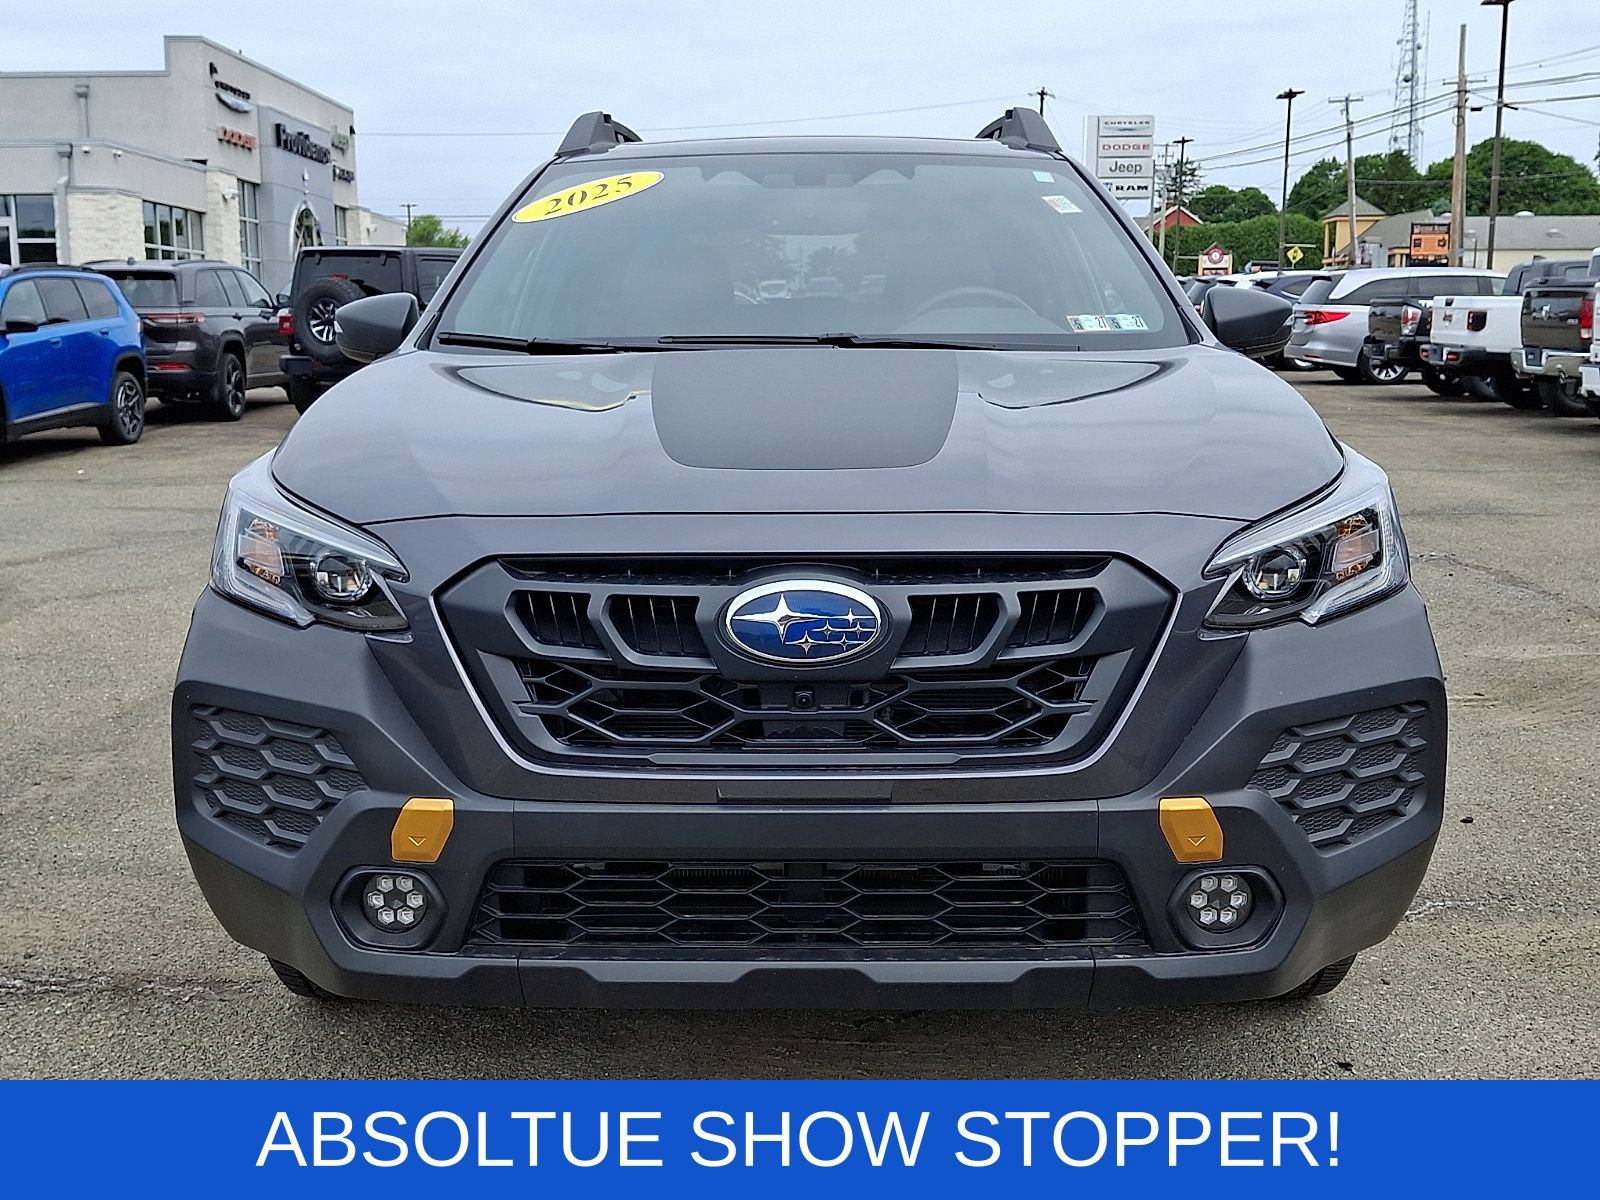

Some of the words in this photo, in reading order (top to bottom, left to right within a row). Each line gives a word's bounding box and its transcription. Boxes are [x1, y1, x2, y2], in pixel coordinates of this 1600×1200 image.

[1102, 143, 1151, 151] DODGE
[1109, 160, 1143, 175] Jeep
[544, 175, 633, 216] 2025
[1094, 316, 1107, 329] 27
[1131, 315, 1144, 328] 27
